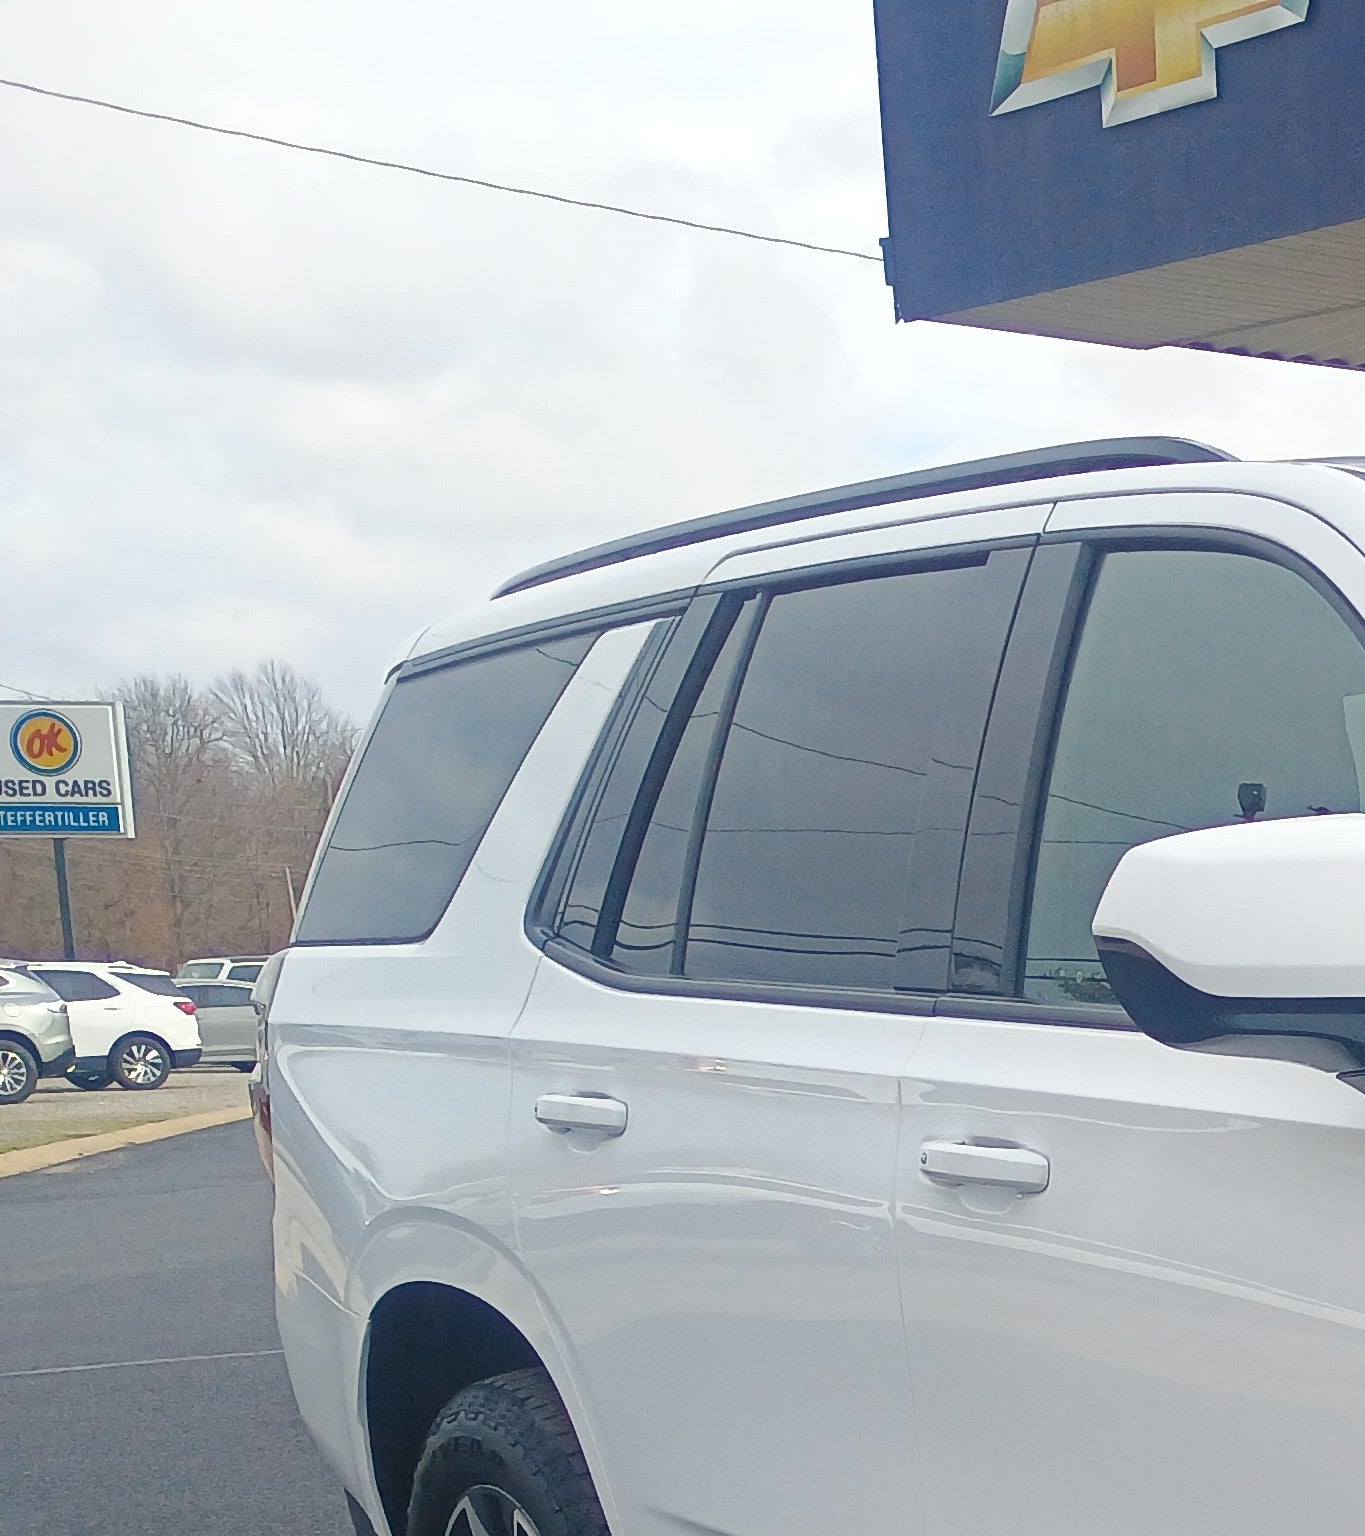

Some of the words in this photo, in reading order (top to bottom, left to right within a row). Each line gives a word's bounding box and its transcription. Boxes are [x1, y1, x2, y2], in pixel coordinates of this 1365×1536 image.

[26, 722, 68, 759] OK
[0, 779, 47, 798] SED
[55, 779, 113, 798] CARS
